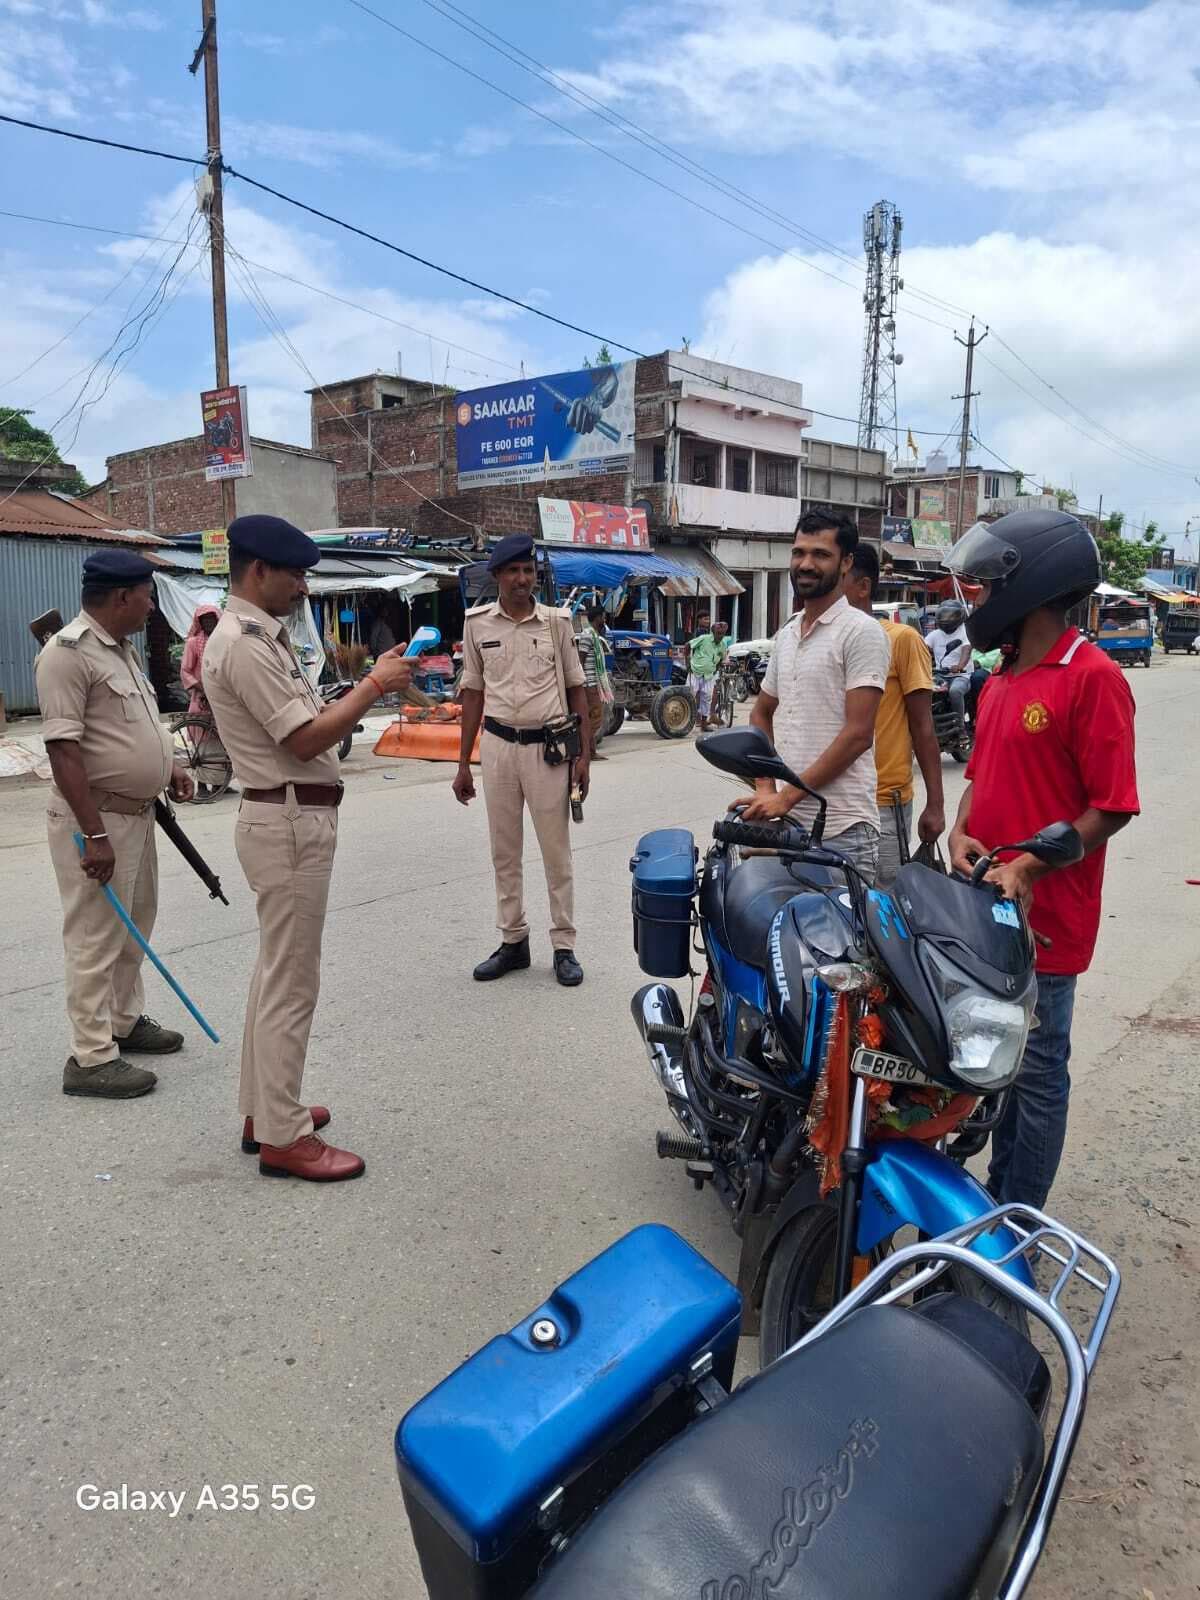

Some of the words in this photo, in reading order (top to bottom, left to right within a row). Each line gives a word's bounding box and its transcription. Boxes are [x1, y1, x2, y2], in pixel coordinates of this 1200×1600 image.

[473, 394, 535, 420] SAAKAAR
[508, 413, 535, 430] TMT
[480, 441, 493, 453] FE
[494, 438, 512, 451] 600
[513, 435, 534, 449] EQR
[771, 910, 791, 1017] GLAMOUR
